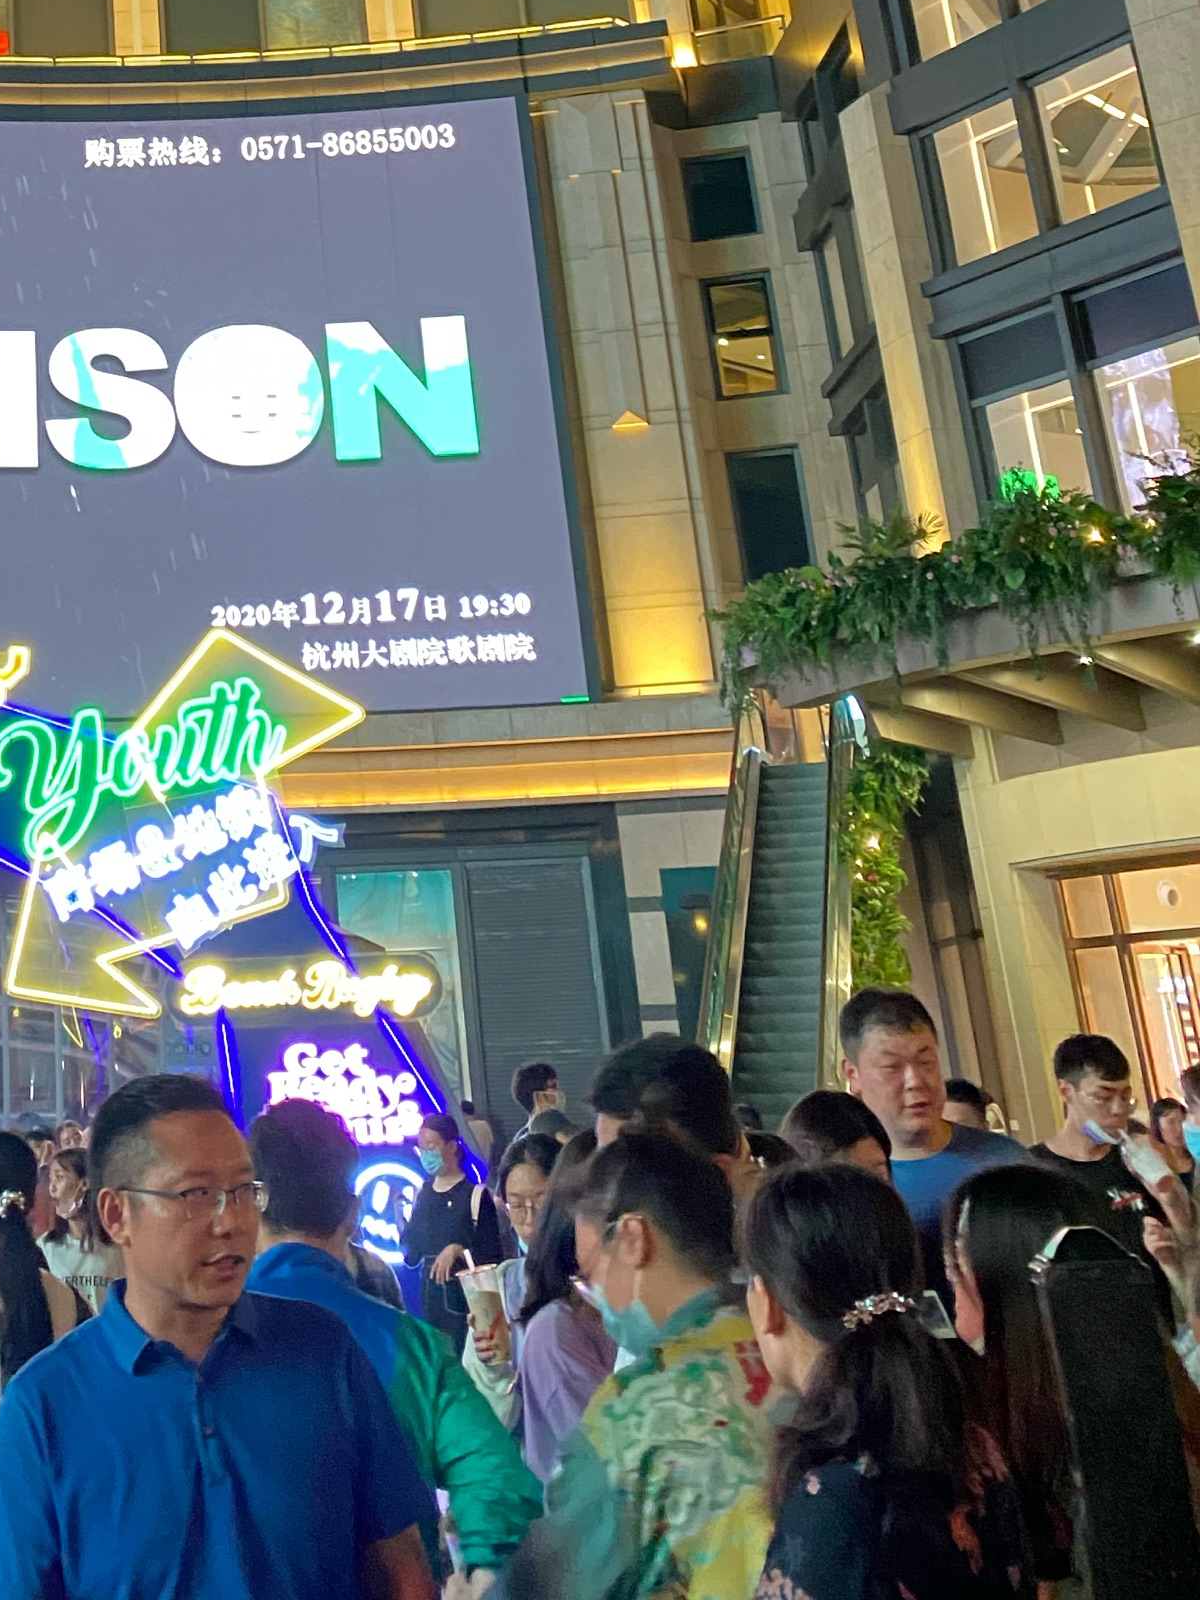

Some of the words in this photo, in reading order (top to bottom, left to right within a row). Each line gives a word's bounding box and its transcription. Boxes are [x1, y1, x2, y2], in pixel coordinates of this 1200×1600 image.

[241, 123, 456, 161] 0571-86855003
[211, 587, 448, 628] 2020年12月17日
[459, 593, 532, 618] 19:30
[302, 631, 538, 671] 杭州大剧院歌剧院
[284, 1043, 367, 1077] Get
[268, 1072, 417, 1118] Ready
